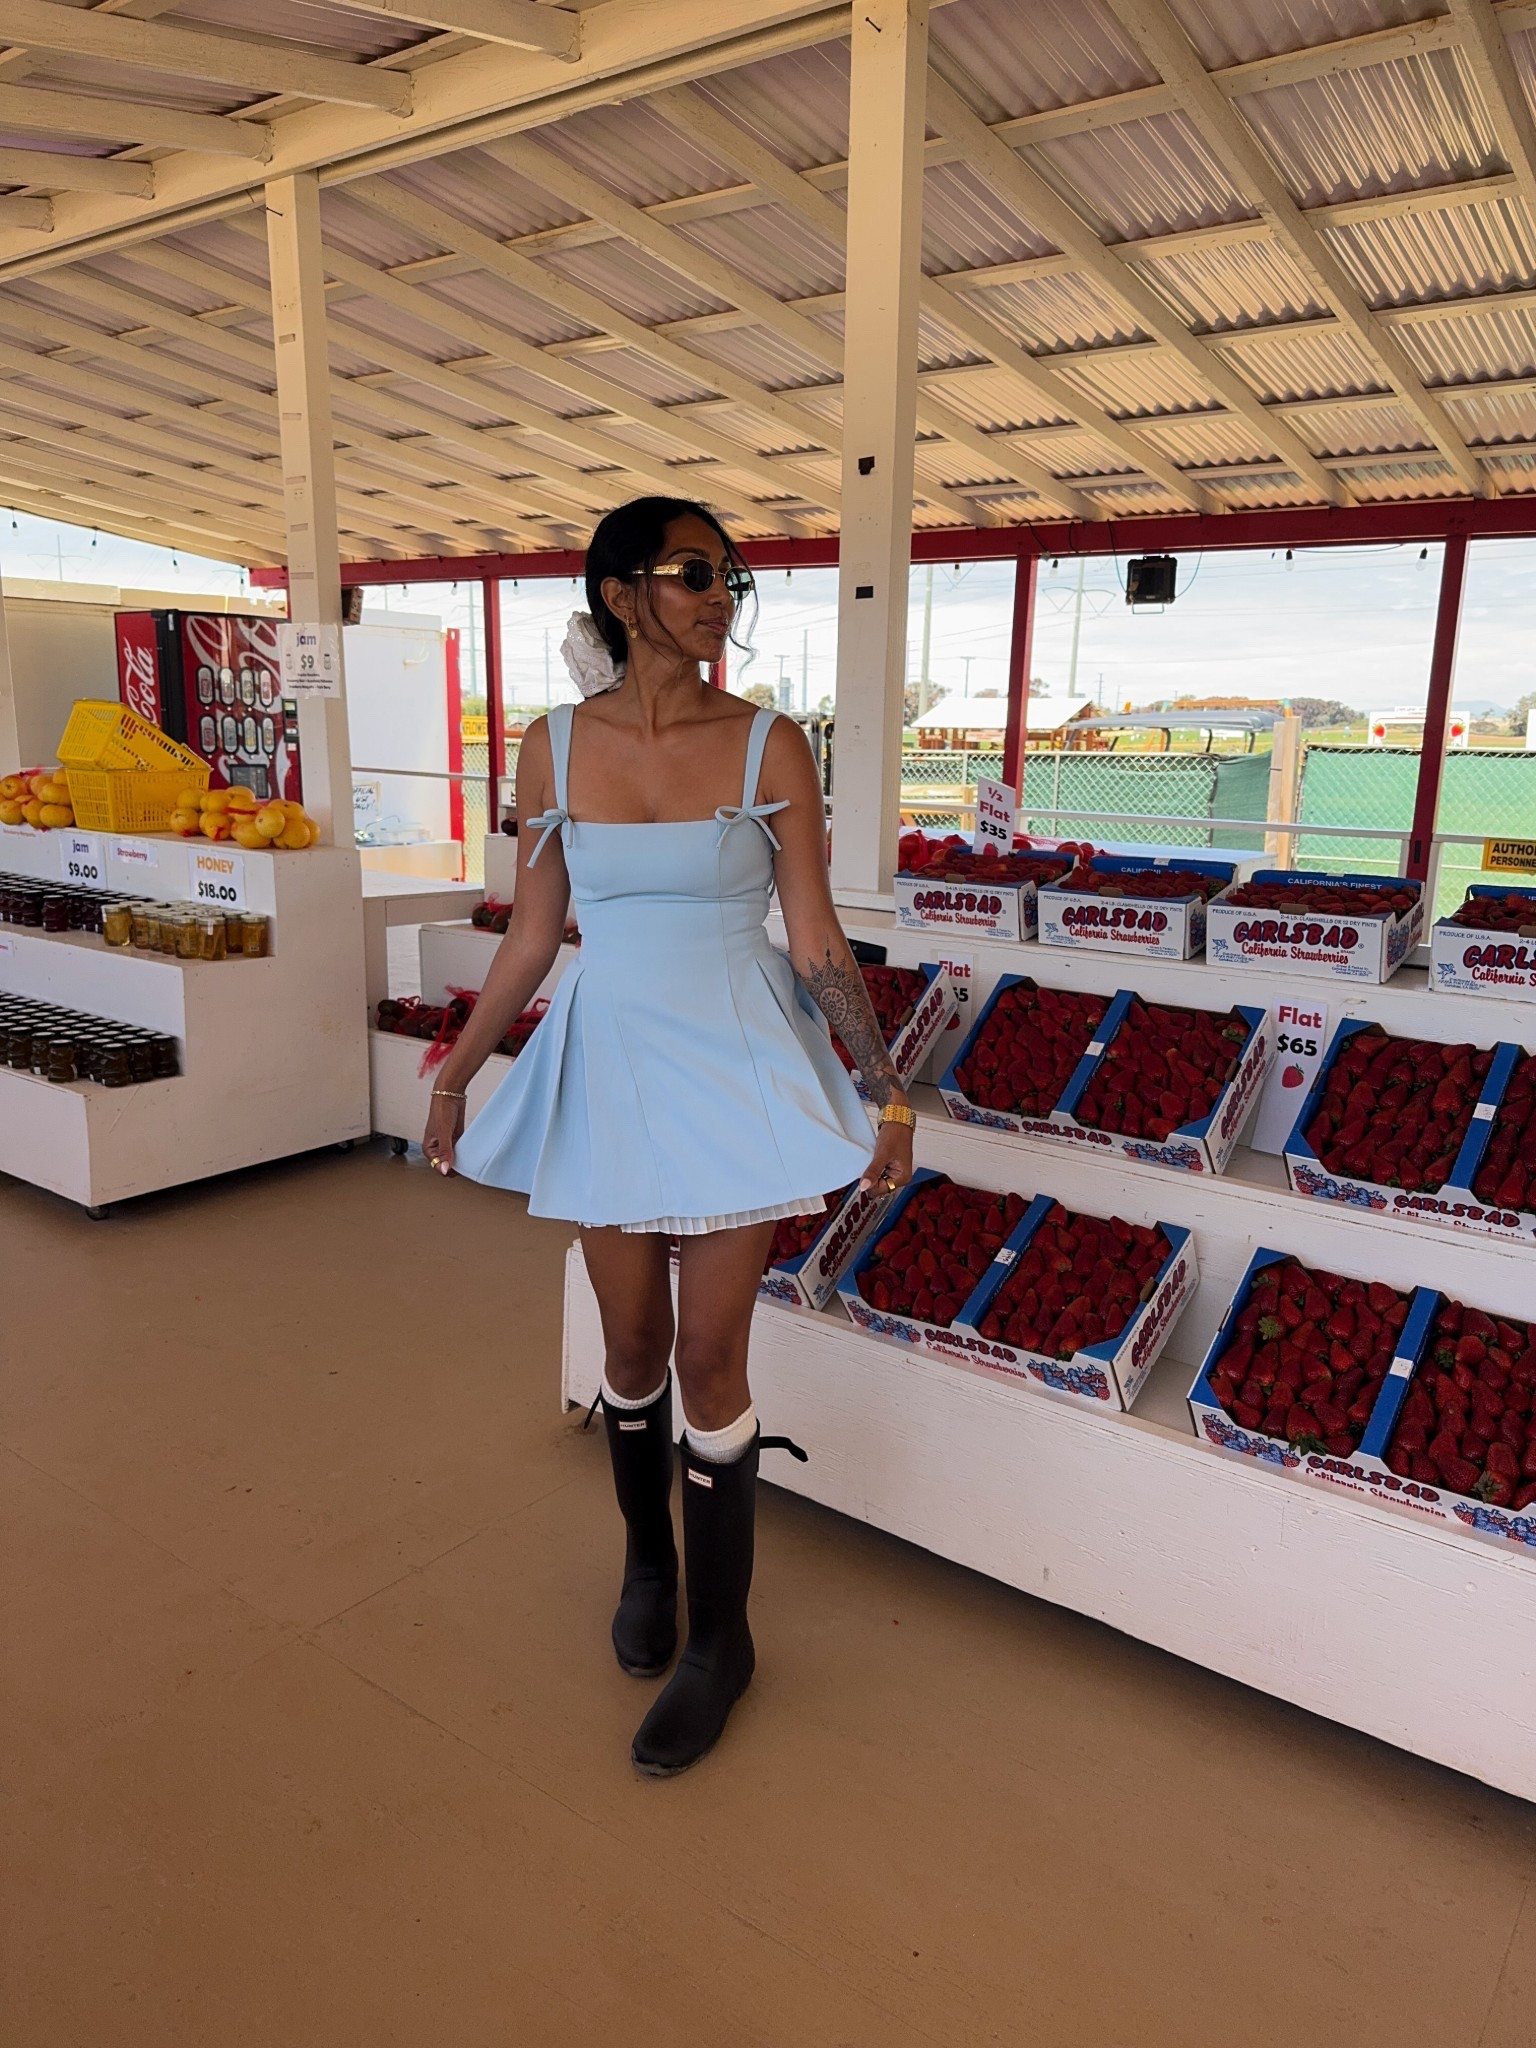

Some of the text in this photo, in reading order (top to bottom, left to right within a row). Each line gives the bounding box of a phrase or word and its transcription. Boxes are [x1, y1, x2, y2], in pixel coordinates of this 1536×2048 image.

[296, 632, 317, 647] jam
[301, 654, 314, 670] $9
[979, 800, 1011, 823] Flat
[980, 820, 1007, 840] $35
[72, 840, 89, 853] jam
[116, 847, 148, 861] Strawberry
[1492, 842, 1536, 856] AUTHO
[68, 861, 98, 879] $9.00
[196, 856, 234, 875] HONEY
[198, 880, 237, 902] $18.00
[913, 890, 1002, 915] CARLSBAD
[920, 909, 953, 923] California
[955, 912, 997, 928] Strawberries
[1062, 905, 1168, 932] CARLSBAD
[1069, 924, 1108, 941] California
[1111, 928, 1160, 946] Strawberries
[1233, 920, 1359, 950] CARLSBAD
[1439, 930, 1465, 938] PRODUCE
[1241, 941, 1287, 959] California
[1290, 945, 1349, 965] Strawberries
[1472, 966, 1526, 986] California
[1278, 1005, 1322, 1029] Flat
[895, 987, 943, 1075] CARLSBAD
[1277, 1033, 1317, 1057] $65
[1022, 1120, 1113, 1146] CARLSBAD
[1394, 1194, 1520, 1228] CARLSBAD
[819, 1191, 869, 1277] CARLSBA
[1131, 1259, 1186, 1368] CARLSBAD
[924, 1328, 1017, 1363] CARLSBAD
[689, 1472, 711, 1484] HUNTER
[1307, 1455, 1441, 1503] CARLSBAD
